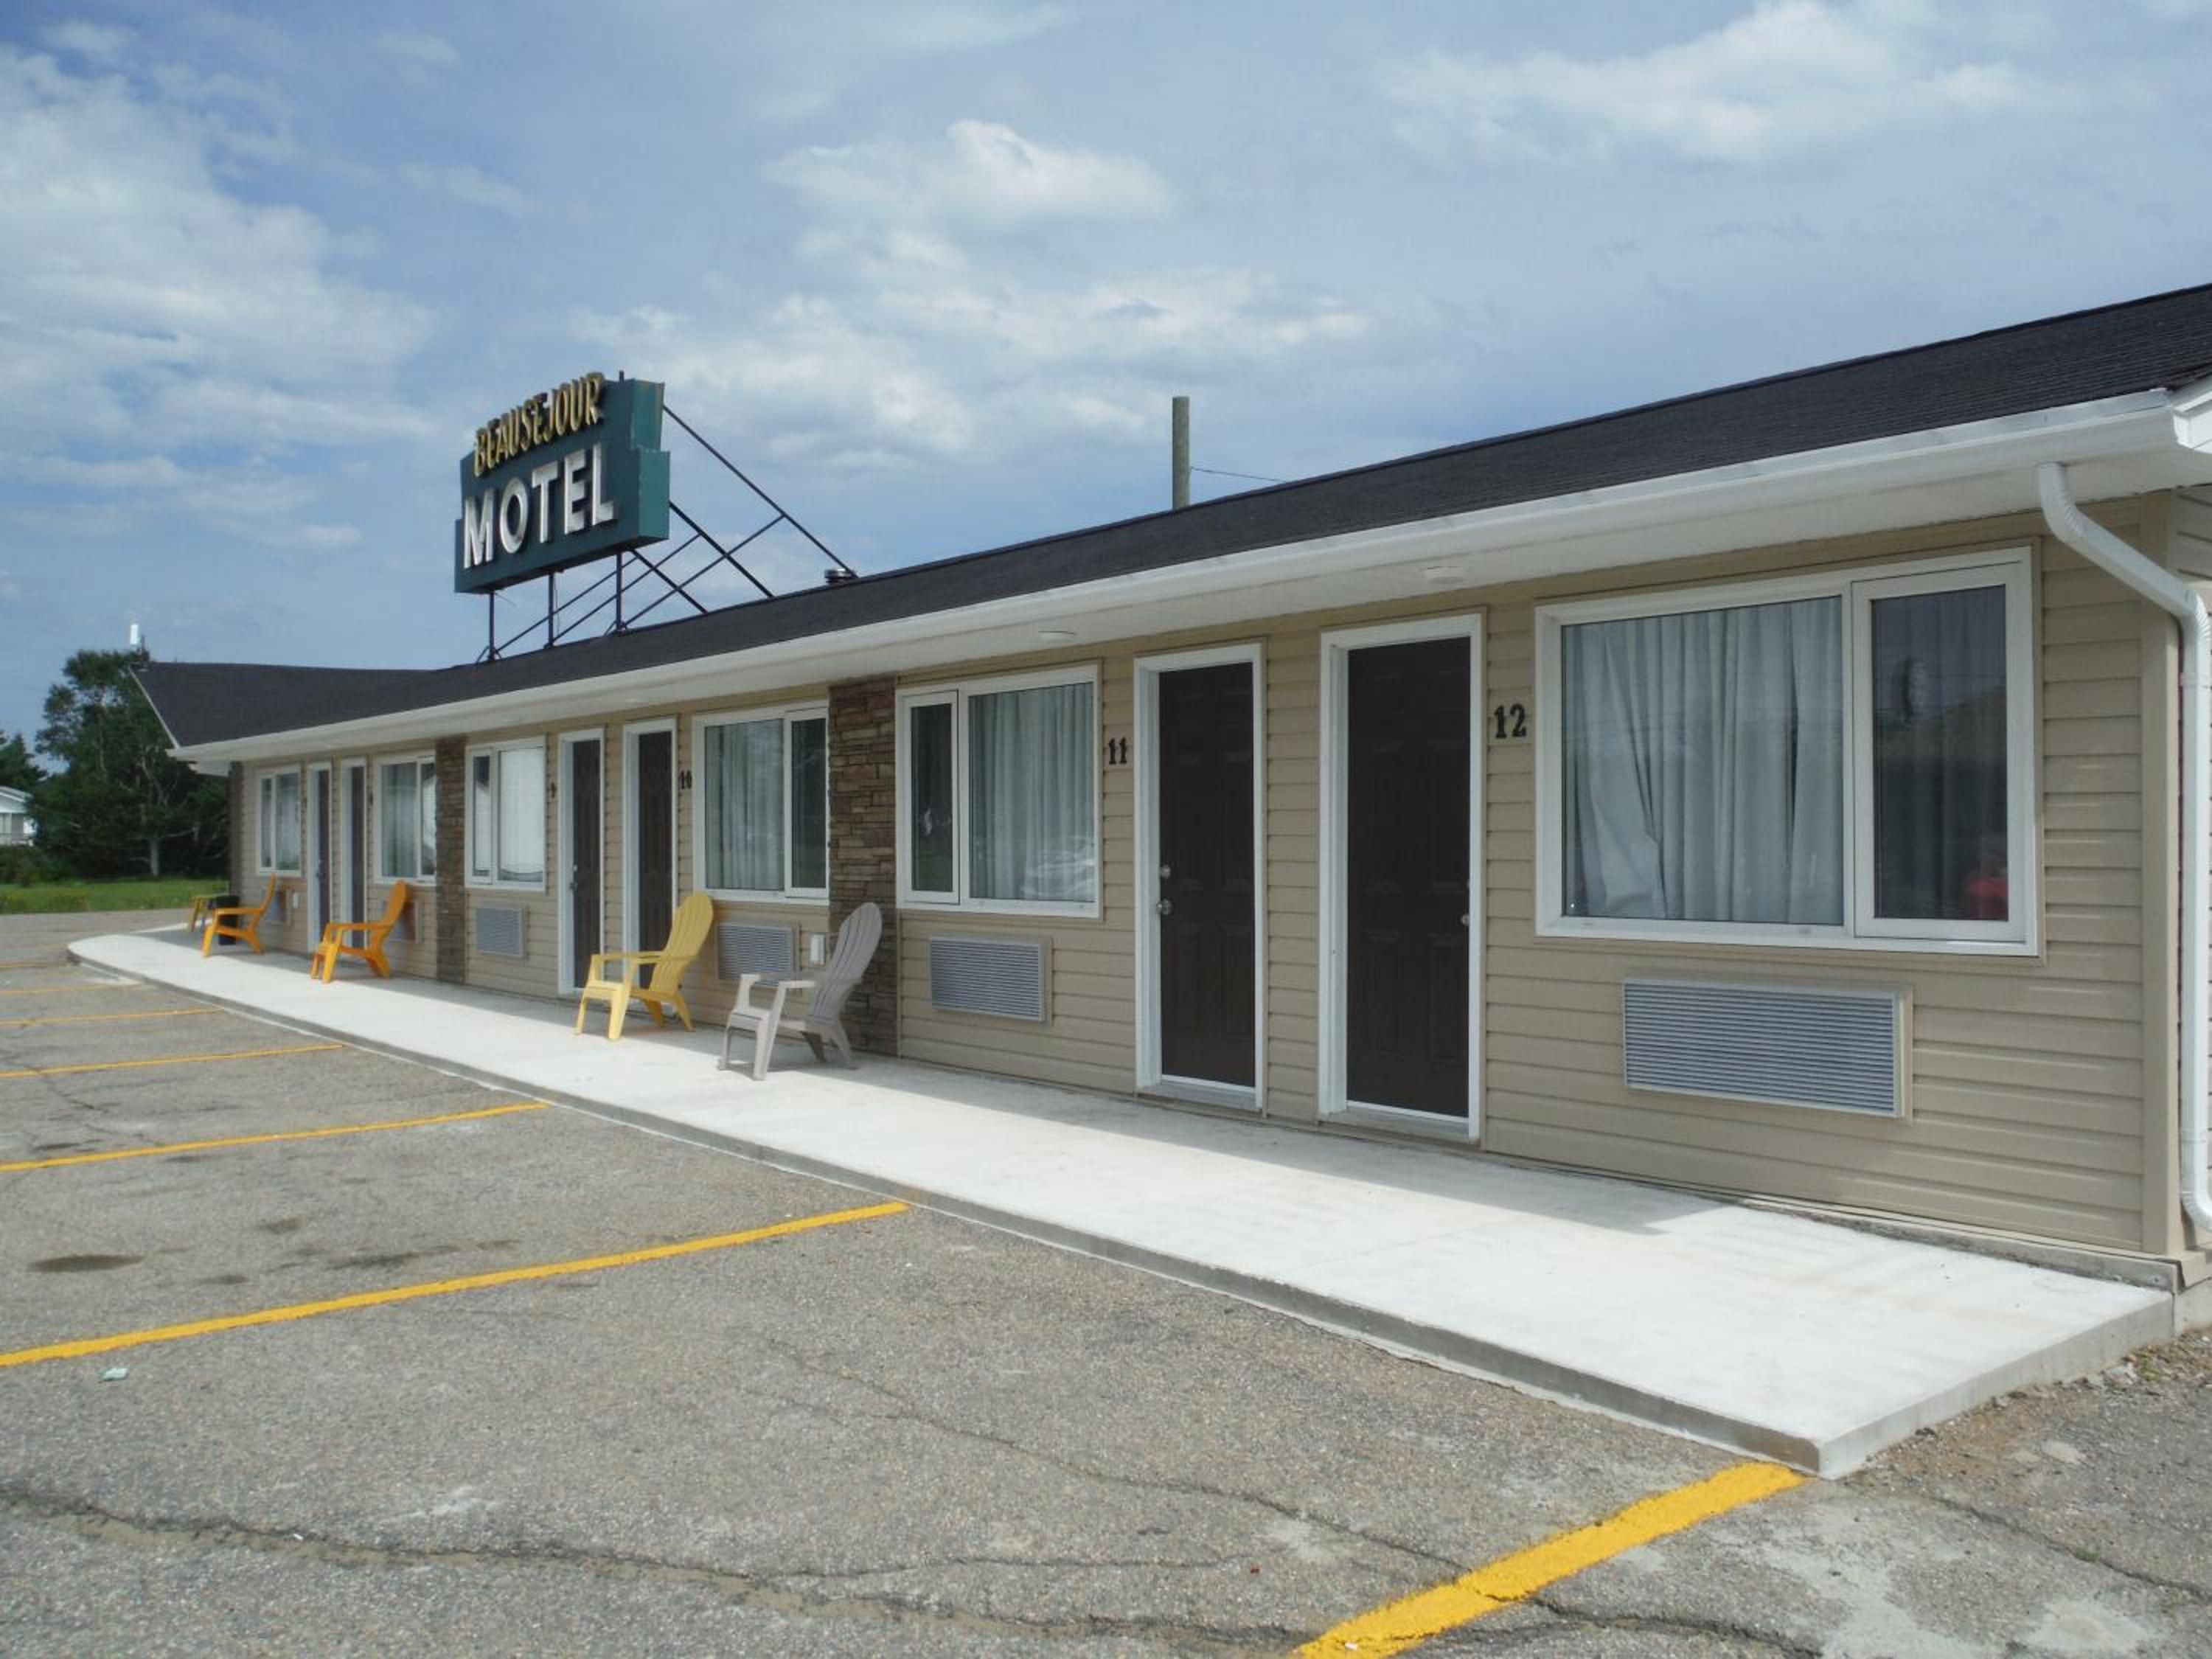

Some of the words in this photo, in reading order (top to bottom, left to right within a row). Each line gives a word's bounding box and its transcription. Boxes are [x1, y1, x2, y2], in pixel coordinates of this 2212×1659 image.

[473, 372, 604, 477] BEAUSEJOUR
[464, 442, 613, 569] MOTEL
[1108, 737, 1127, 765] 11
[1494, 703, 1527, 739] 12
